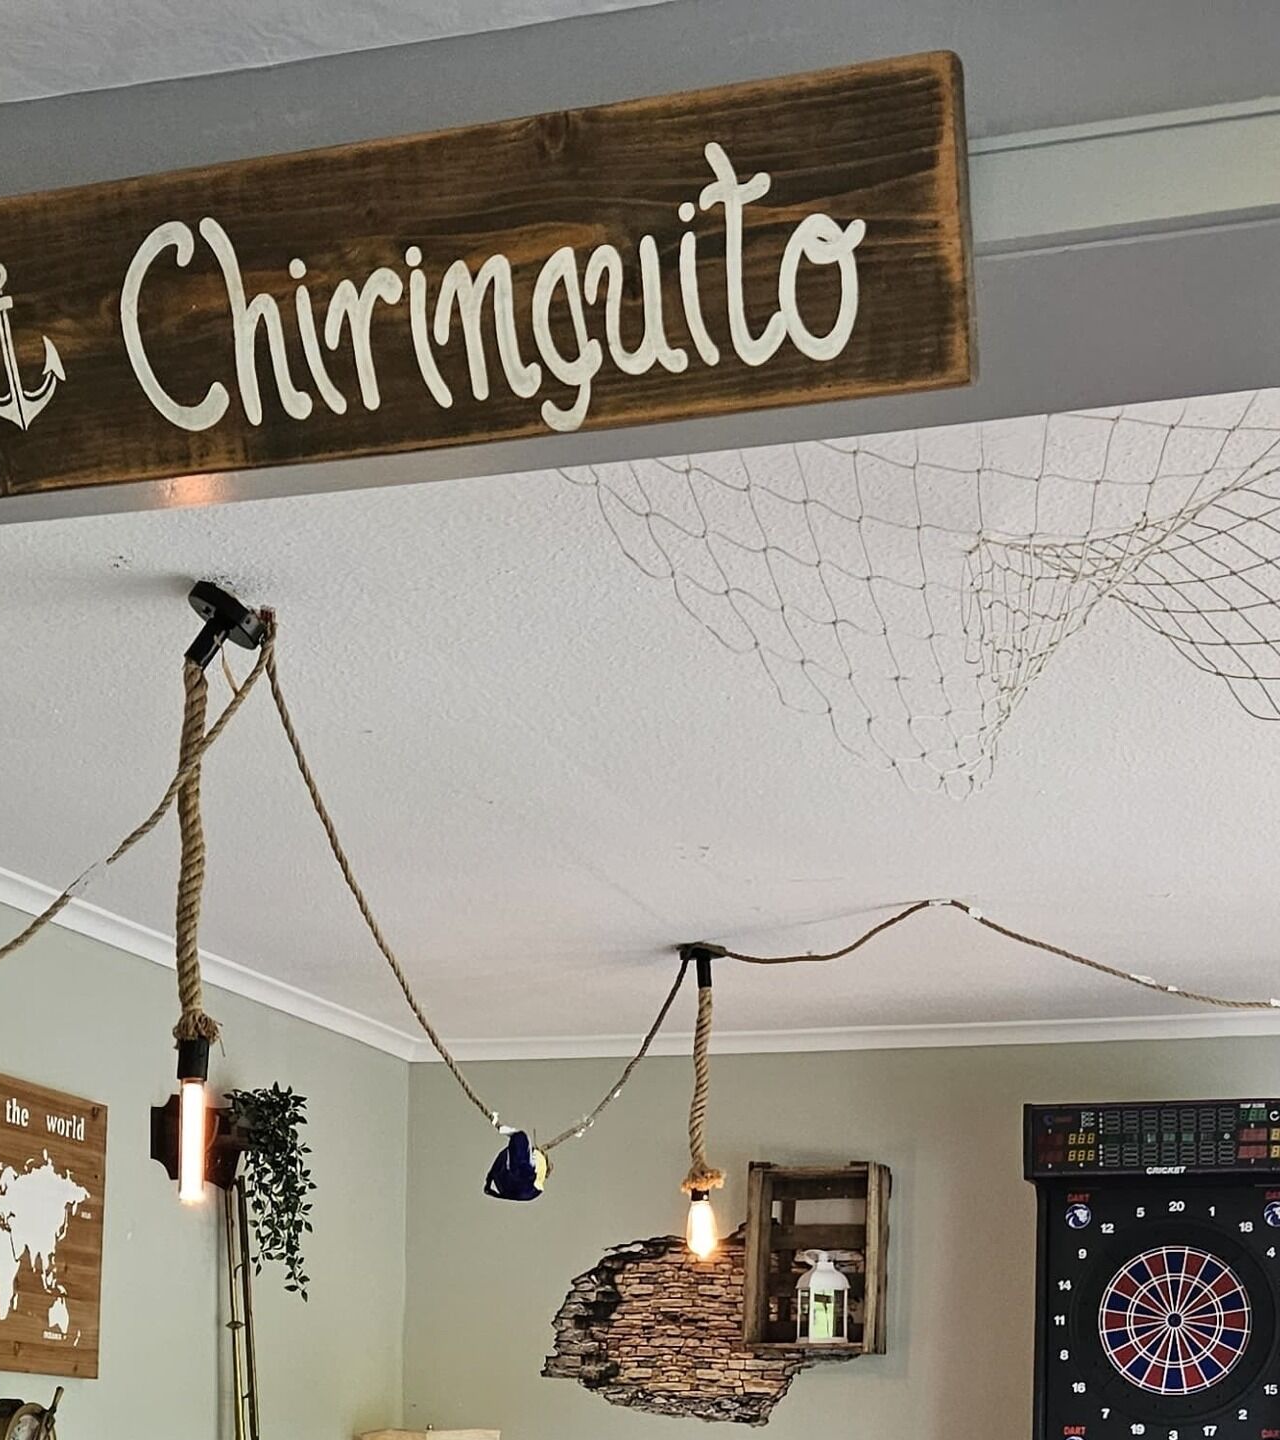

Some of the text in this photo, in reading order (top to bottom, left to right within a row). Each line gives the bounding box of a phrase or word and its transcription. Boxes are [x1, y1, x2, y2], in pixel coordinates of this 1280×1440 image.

[120, 141, 867, 432] Chiringuito
[5, 1098, 30, 1127] the
[46, 1114, 86, 1142] world
[1146, 1166, 1187, 1175] CRICKET
[1169, 1201, 1186, 1211] 20
[1208, 1206, 1216, 1216] 1
[1136, 1207, 1146, 1217] 5
[1100, 1223, 1115, 1233] 12
[1239, 1222, 1254, 1232] 18
[1078, 1248, 1088, 1259] 9
[1266, 1247, 1277, 1258] 4
[1057, 1279, 1073, 1290] 14
[1053, 1315, 1066, 1325] 11
[1059, 1349, 1070, 1360] 8
[1071, 1382, 1087, 1393] 16
[1263, 1384, 1279, 1395] 15
[1101, 1407, 1111, 1419] 7
[1238, 1409, 1249, 1420] 2
[1063, 1426, 1087, 1436] DART
[1130, 1423, 1146, 1435] 19
[1202, 1425, 1218, 1437] 17
[1169, 1430, 1180, 1440] 3
